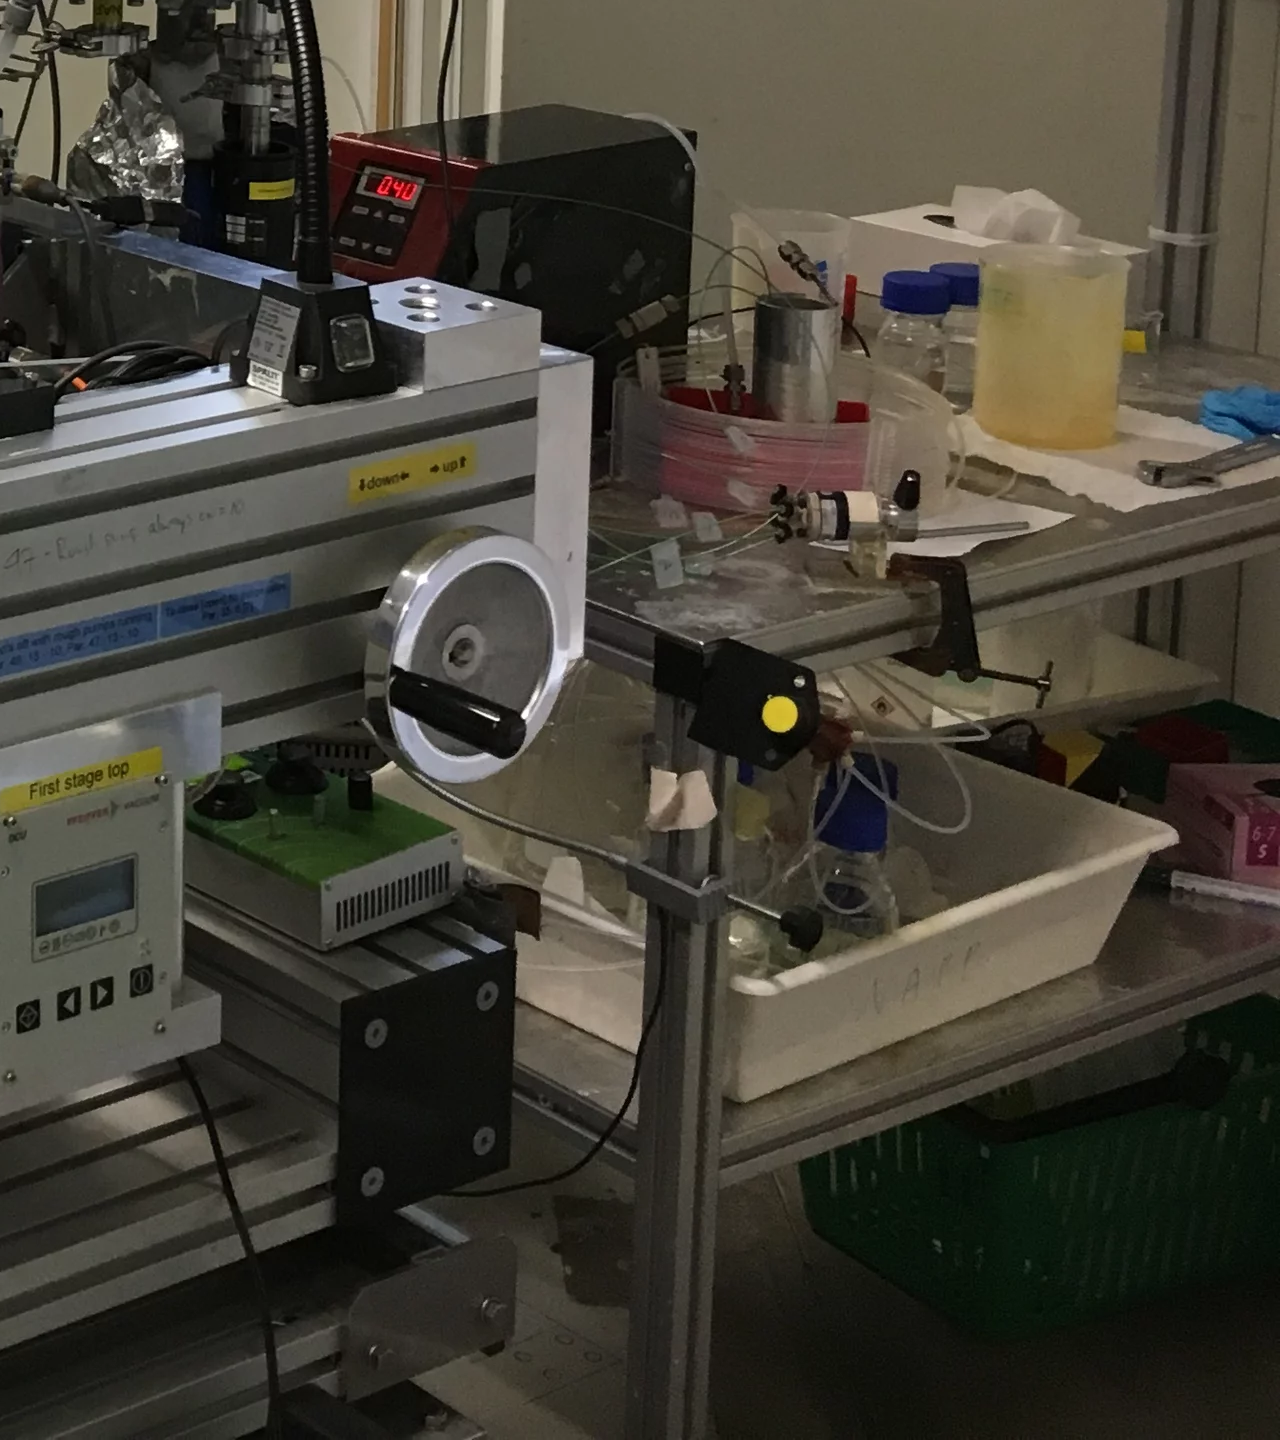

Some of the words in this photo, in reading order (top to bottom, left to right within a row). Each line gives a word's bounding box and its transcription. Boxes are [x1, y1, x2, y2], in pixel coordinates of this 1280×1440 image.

[366, 468, 400, 491] down
[442, 459, 459, 477] up
[29, 781, 56, 802] First
[59, 768, 101, 796] stage
[105, 759, 130, 785] top
[66, 806, 109, 827] PFEIFFER
[123, 793, 161, 811] VACUUM
[1257, 844, 1267, 859] S
